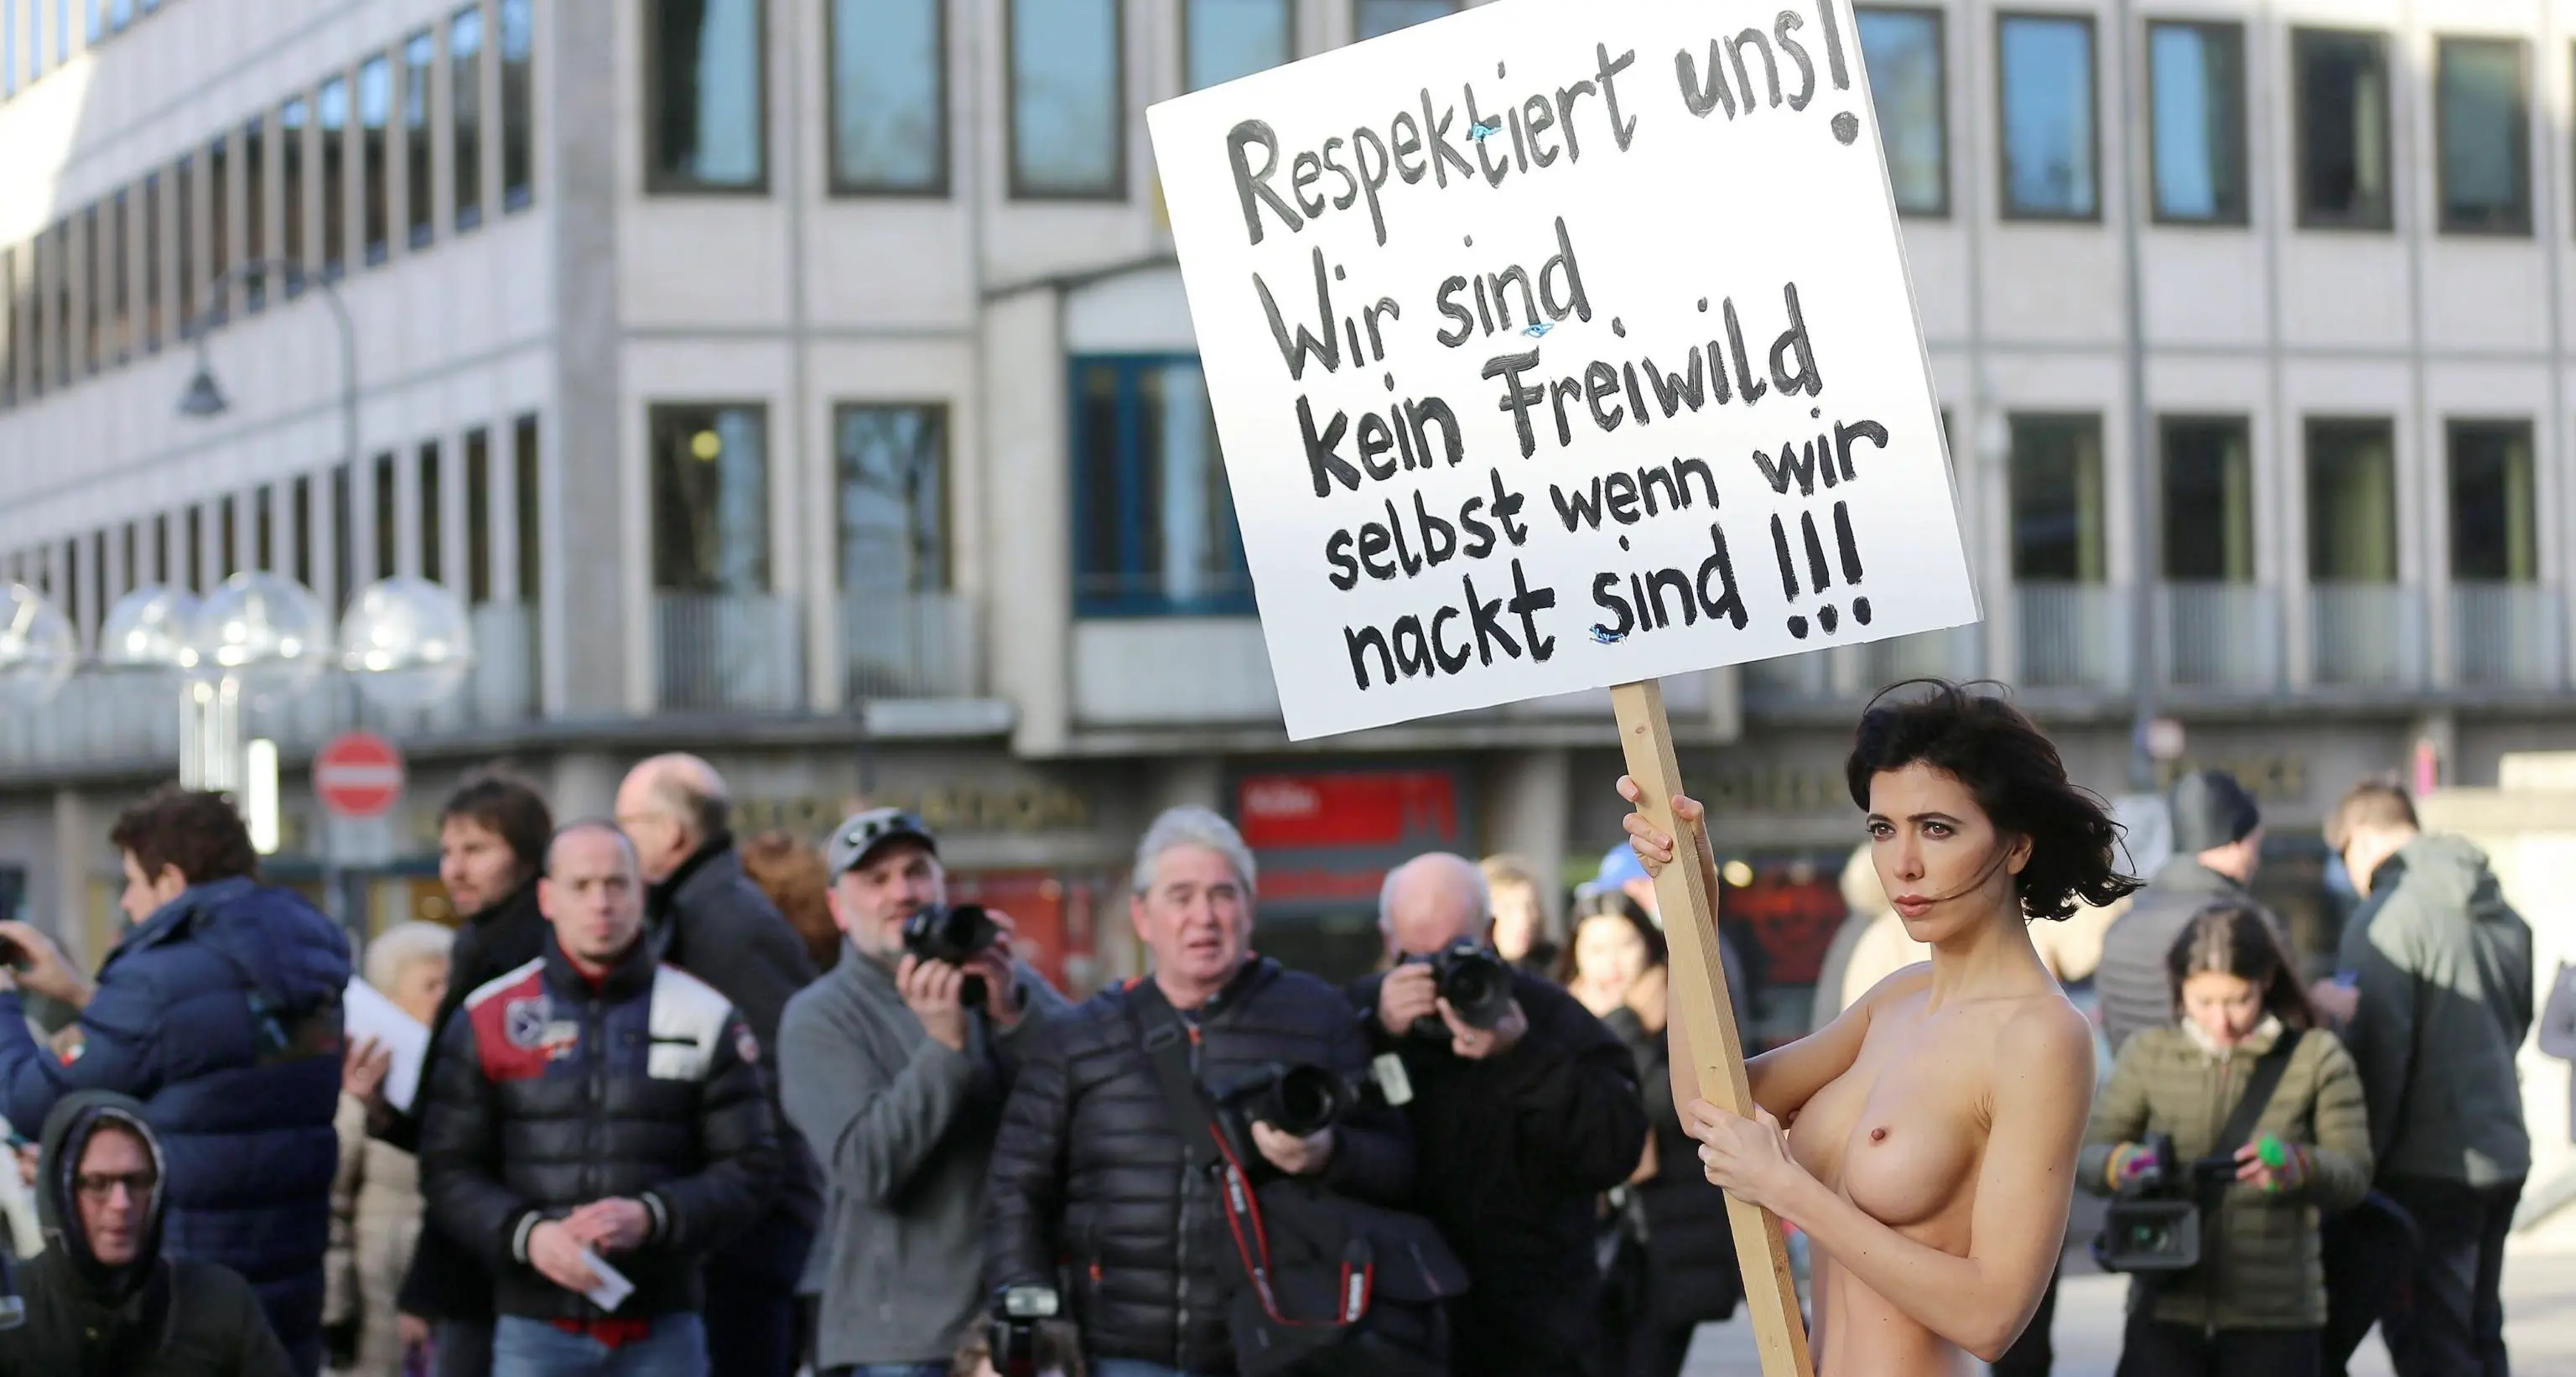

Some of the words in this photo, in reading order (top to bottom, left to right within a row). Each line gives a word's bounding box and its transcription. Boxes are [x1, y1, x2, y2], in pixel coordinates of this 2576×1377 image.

[1227, 43, 1636, 247] Respektiert
[1675, 0, 1858, 146] uns!
[1253, 246, 1400, 382] Wir
[1436, 216, 1592, 348] sind
[1296, 372, 1465, 499] kein
[1482, 282, 1822, 460] Freiwild
[1326, 467, 1528, 592] selbst
[1550, 456, 1719, 534] wenn
[1753, 407, 1888, 498] wir
[1343, 558, 1555, 692] nackt
[1589, 522, 1749, 646] sind
